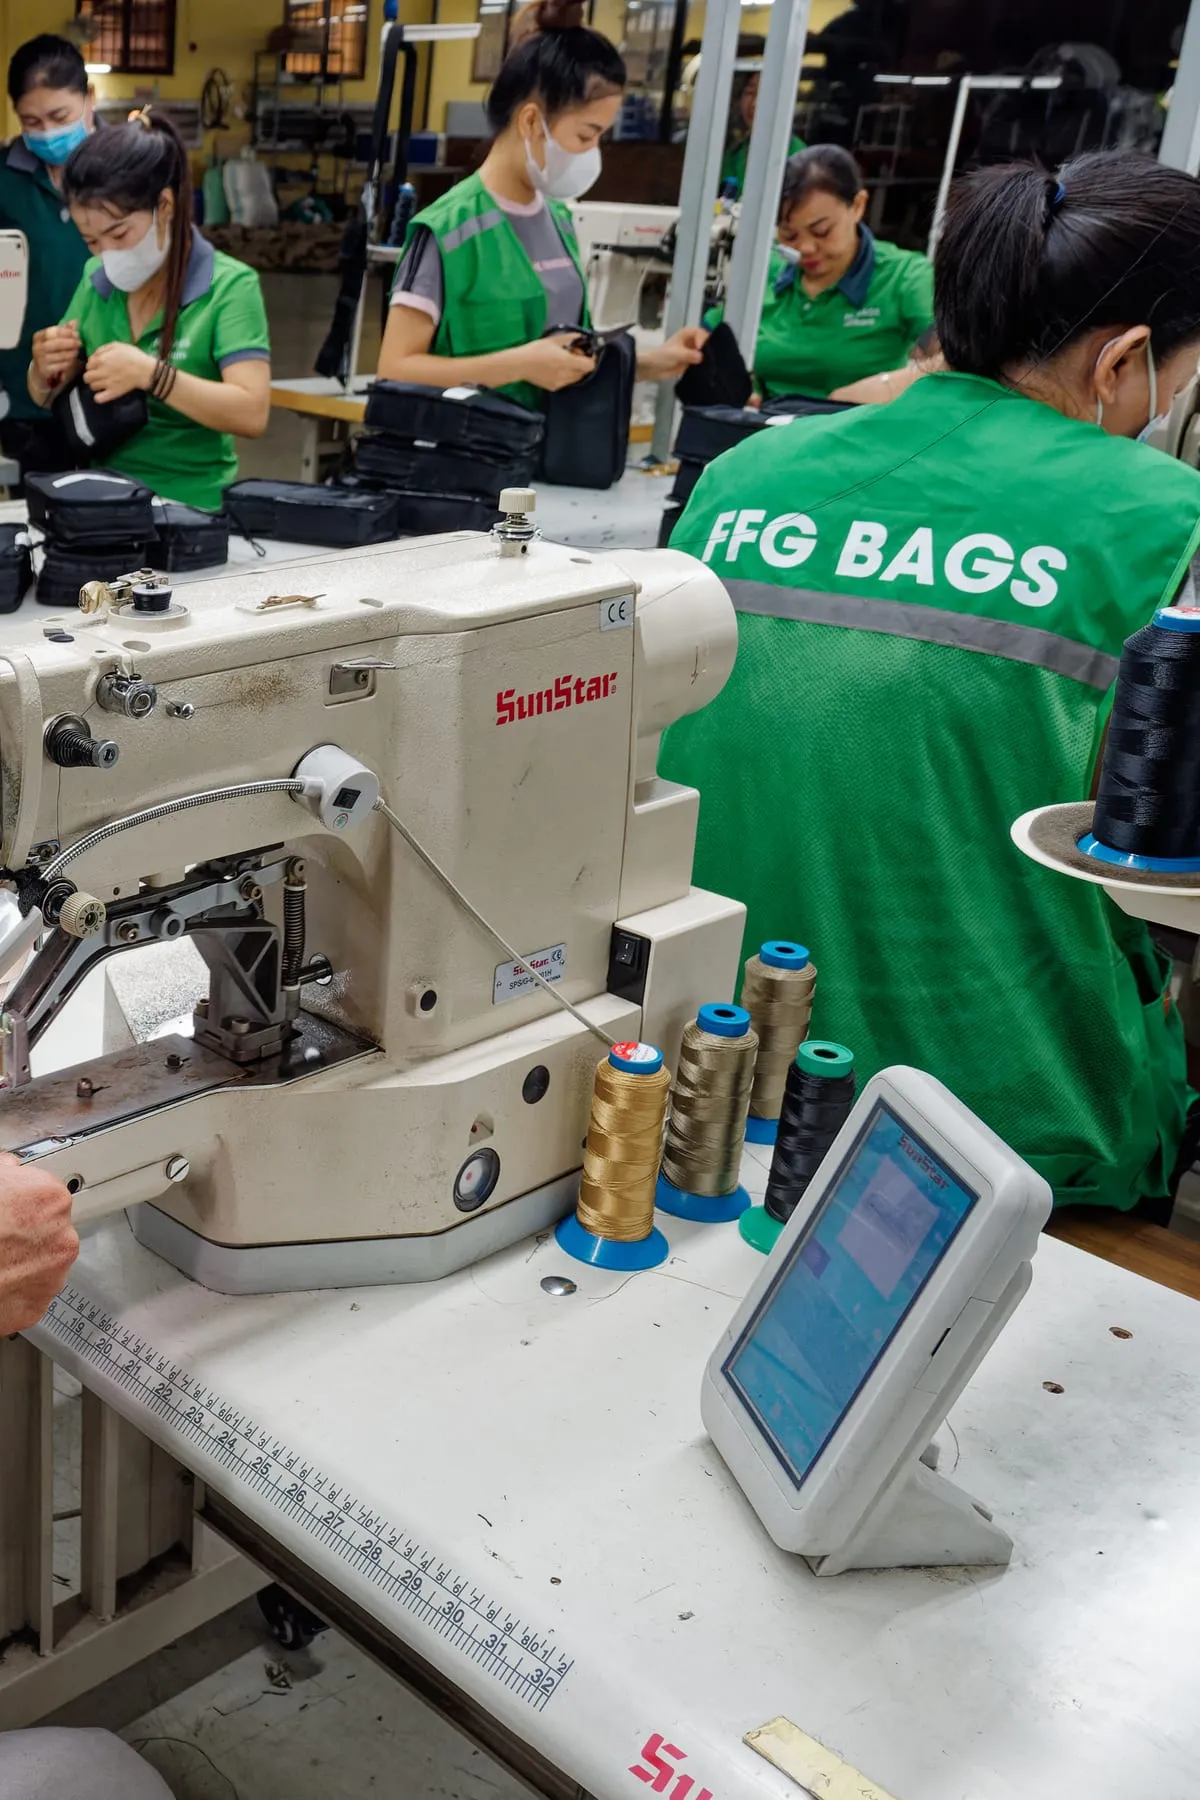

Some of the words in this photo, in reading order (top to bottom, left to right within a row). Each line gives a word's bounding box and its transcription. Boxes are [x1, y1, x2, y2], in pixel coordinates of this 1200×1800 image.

[701, 509, 818, 568] FFG
[835, 520, 1067, 608] BAGS
[496, 672, 618, 726] SunStar
[69, 1317, 85, 1333] 19
[95, 1338, 113, 1355] 20
[124, 1359, 142, 1376] 21
[154, 1382, 172, 1400] 22
[186, 1406, 204, 1424] 23
[218, 1430, 238, 1449] 24
[252, 1456, 272, 1476] 25
[286, 1482, 307, 1502] 26
[322, 1510, 345, 1530] 27
[360, 1540, 382, 1560] 28
[400, 1570, 422, 1591] 29
[442, 1601, 464, 1624] 30
[485, 1634, 508, 1656] 31
[530, 1668, 555, 1694] 32
